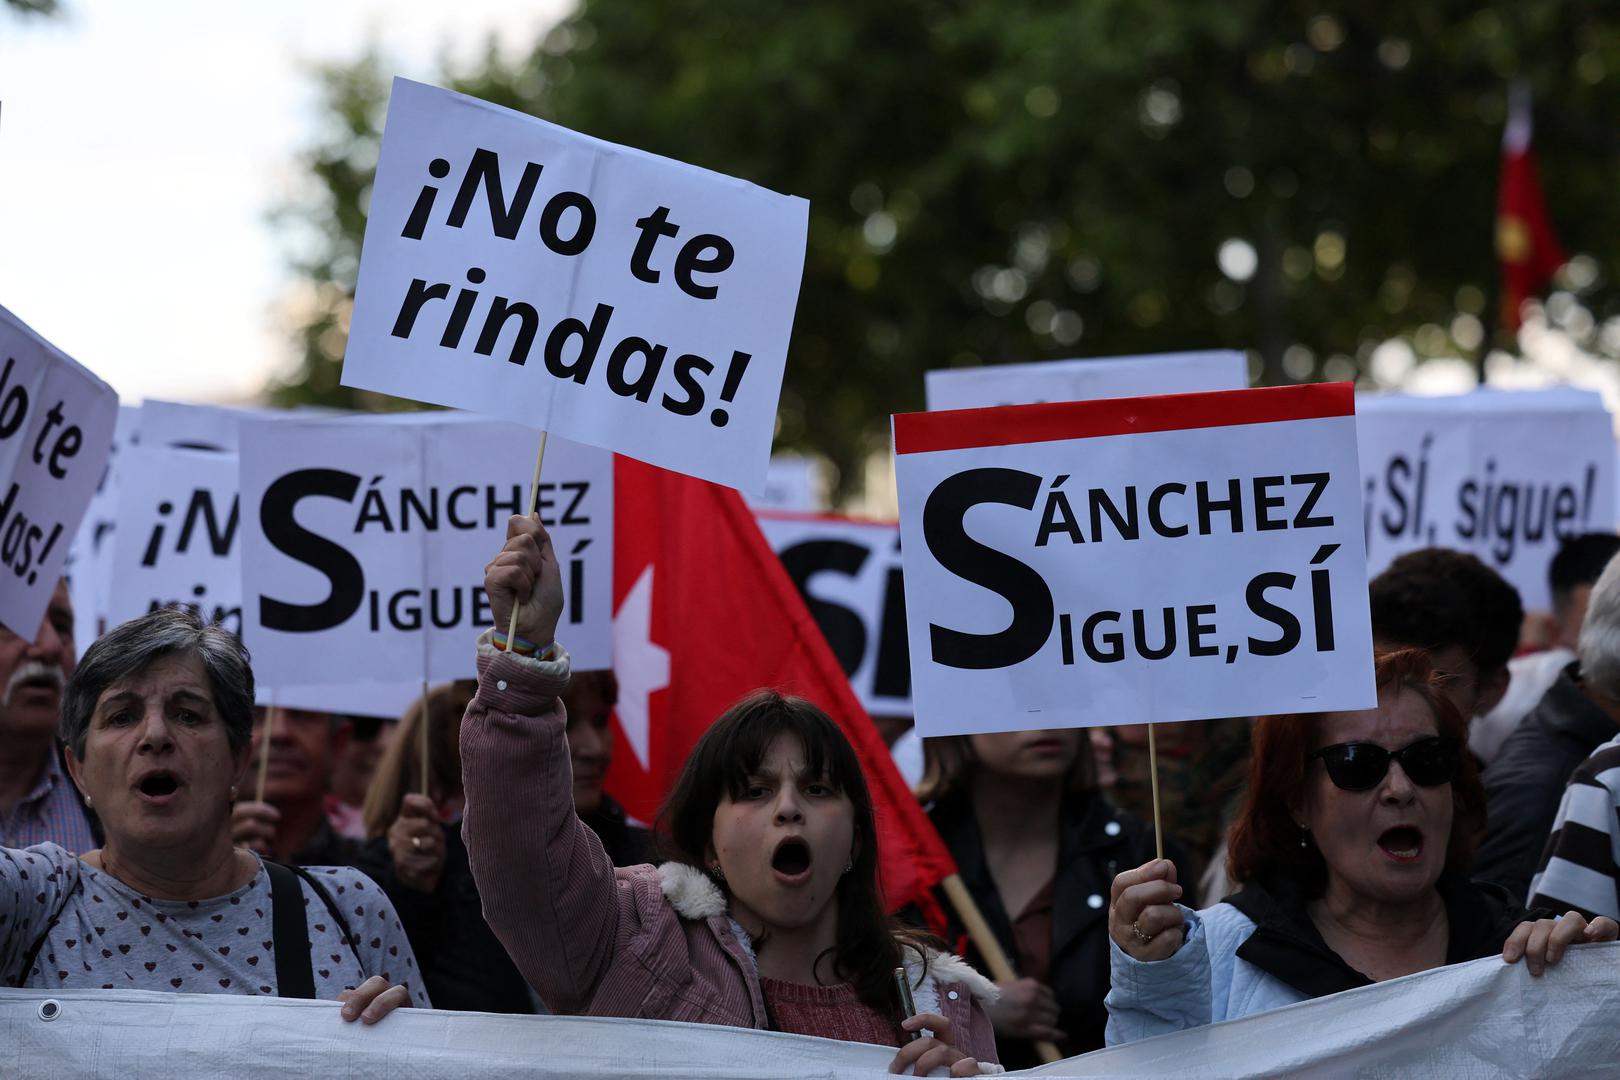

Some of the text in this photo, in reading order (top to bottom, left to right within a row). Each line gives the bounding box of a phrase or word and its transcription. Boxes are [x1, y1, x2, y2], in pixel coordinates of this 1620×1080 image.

[400, 147, 735, 300] ¡No te
[0, 356, 30, 441] o
[32, 400, 83, 481] te
[390, 267, 753, 428] rindas!
